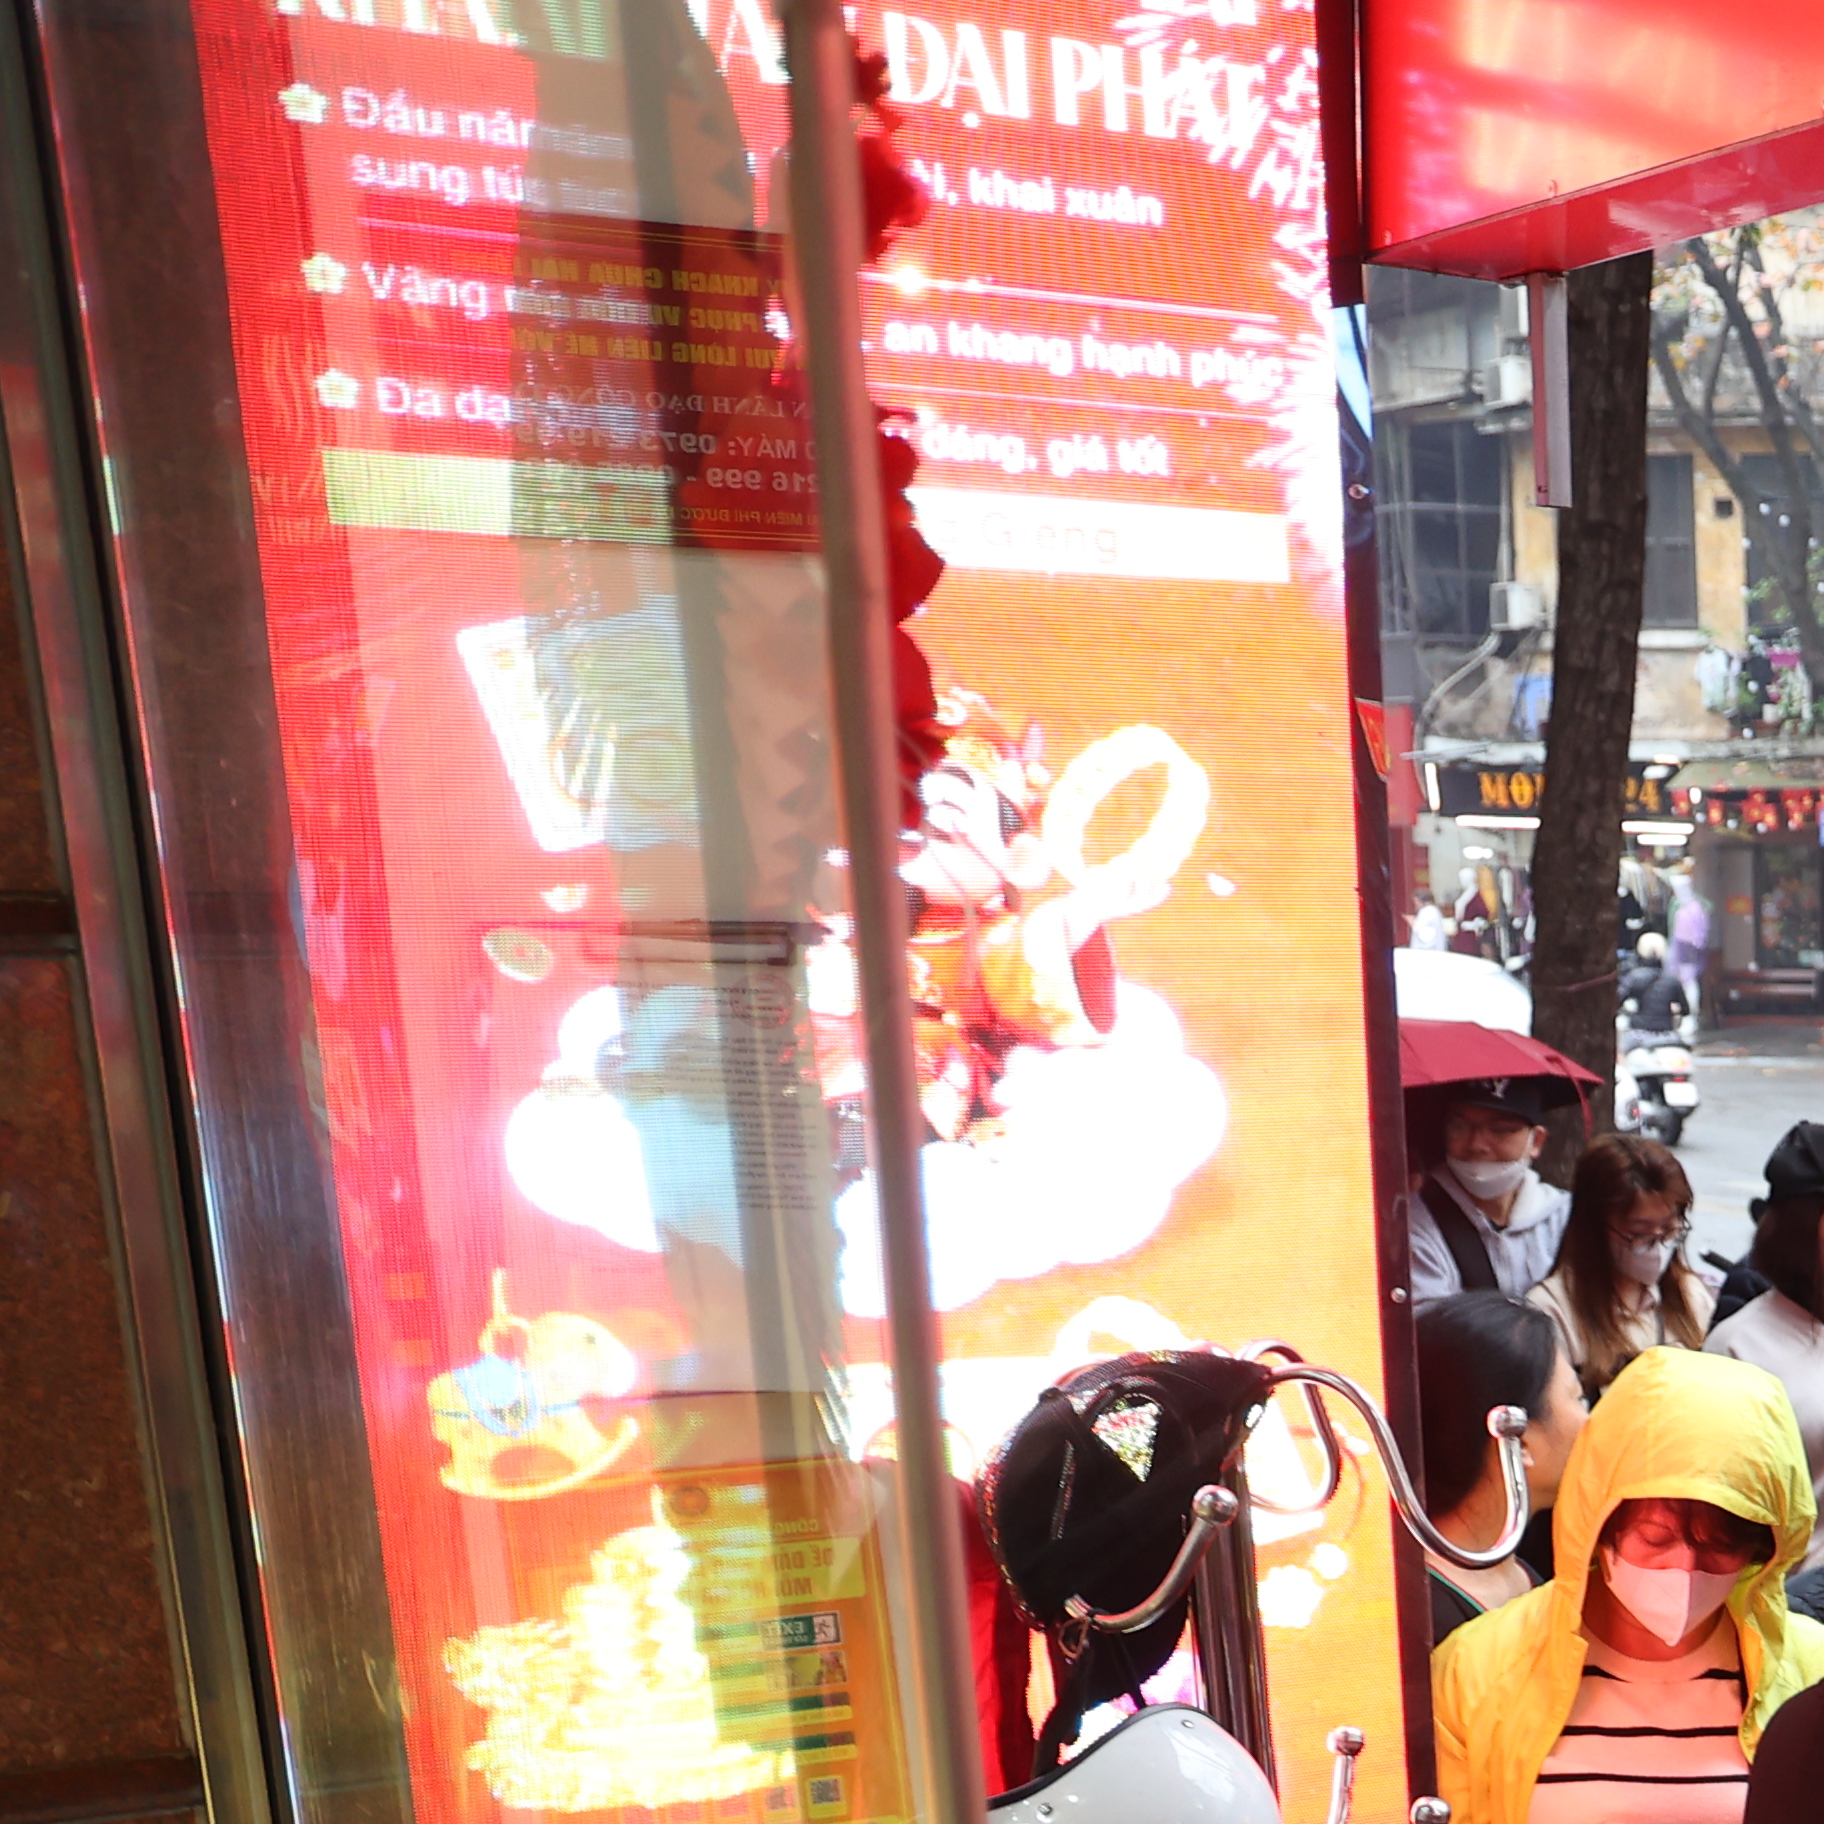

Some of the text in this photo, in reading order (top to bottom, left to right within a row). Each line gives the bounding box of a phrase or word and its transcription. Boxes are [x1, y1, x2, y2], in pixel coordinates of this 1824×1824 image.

[883, 10, 1031, 128] ĐẠI
[350, 152, 471, 206] sung
[967, 165, 1056, 214] khai
[1065, 185, 1164, 226] xuân
[883, 321, 938, 354] an
[947, 320, 1073, 376] khang
